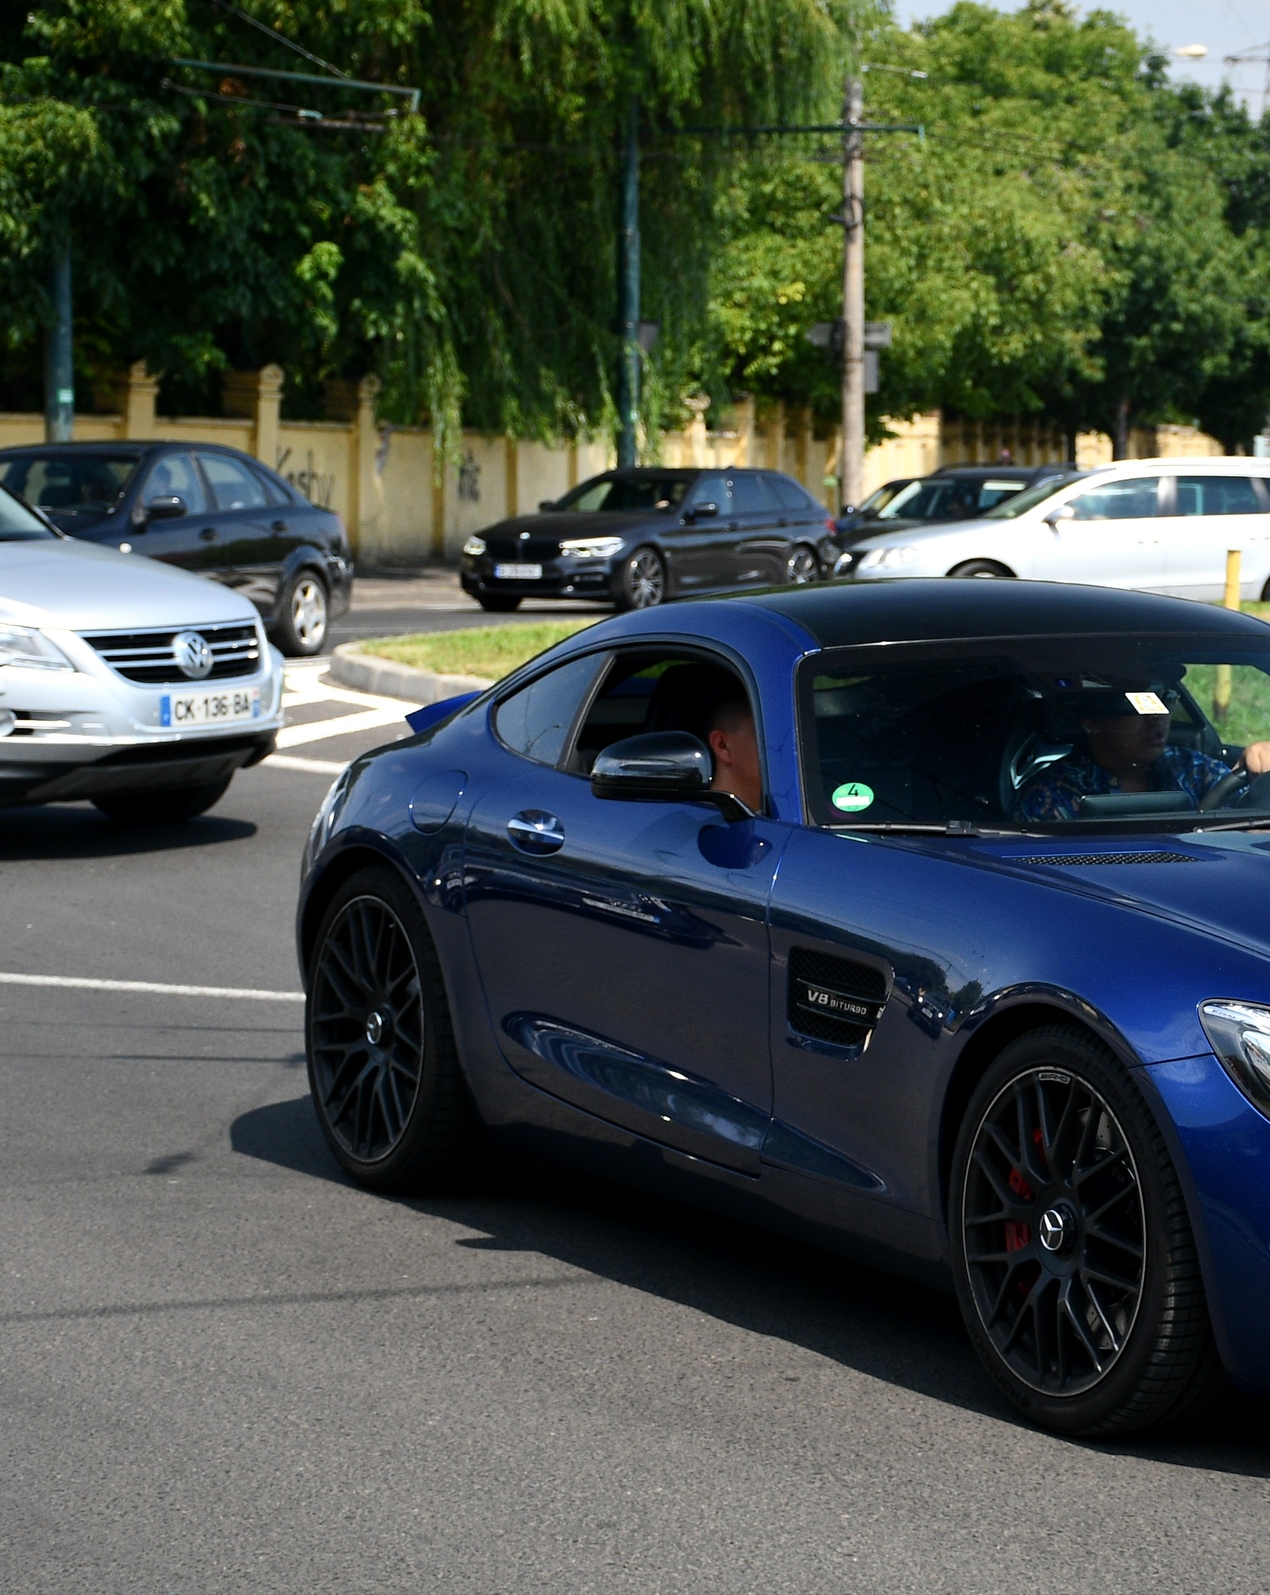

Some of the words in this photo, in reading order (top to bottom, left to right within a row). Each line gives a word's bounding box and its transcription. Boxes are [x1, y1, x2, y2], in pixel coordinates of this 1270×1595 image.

[847, 783, 860, 797] 4
[807, 989, 829, 1005] V8
[829, 999, 868, 1016] BITURBO
